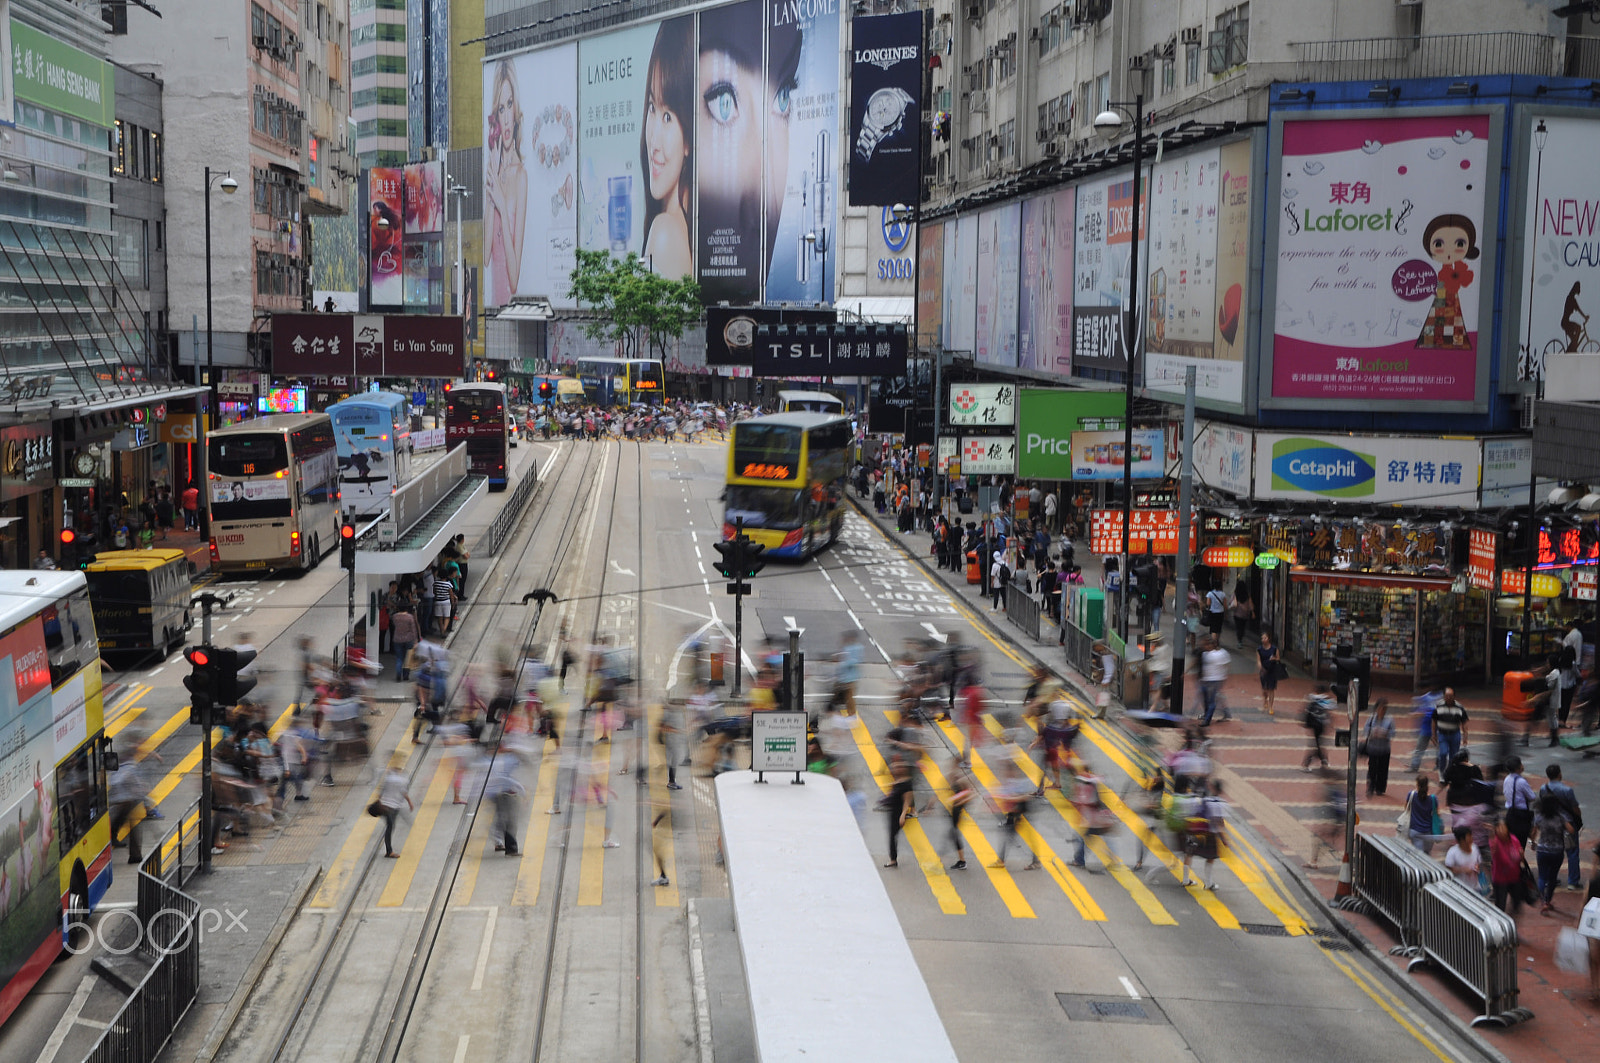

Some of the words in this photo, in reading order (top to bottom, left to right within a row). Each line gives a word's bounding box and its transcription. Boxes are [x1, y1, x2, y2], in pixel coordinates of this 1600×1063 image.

[14, 43, 44, 85] 生銀行
[855, 45, 917, 63] LONGINES
[588, 57, 632, 85] LANEIGE
[46, 62, 66, 91] HANG
[66, 70, 84, 98] SENG
[84, 78, 101, 104] BANK
[1329, 181, 1371, 204] 東角
[1304, 208, 1393, 232] Laforet
[1542, 197, 1600, 236] NEW
[1280, 248, 1335, 262] experience
[1339, 246, 1355, 257] the
[1360, 247, 1382, 261] city
[1385, 246, 1408, 257] chic
[878, 257, 913, 280] SOGO
[1337, 262, 1350, 275] &
[1397, 268, 1416, 284] See
[1417, 269, 1435, 286] you
[1307, 277, 1330, 293] fun
[1334, 277, 1359, 290] with
[1394, 285, 1403, 295] in
[1405, 283, 1437, 297] Laforet
[292, 334, 341, 355] 余仁生
[393, 339, 405, 352] Eu
[409, 339, 426, 352] Yan
[430, 339, 454, 355] Sang
[768, 343, 823, 358] TSL
[837, 342, 891, 358] 謝瑞麟
[170, 417, 197, 439] csl
[1027, 433, 1071, 455] Pric
[243, 463, 255, 474] 116
[1289, 458, 1357, 480] Cetaphil
[1388, 460, 1463, 485] 舒特膚
[226, 534, 244, 543] KMB
